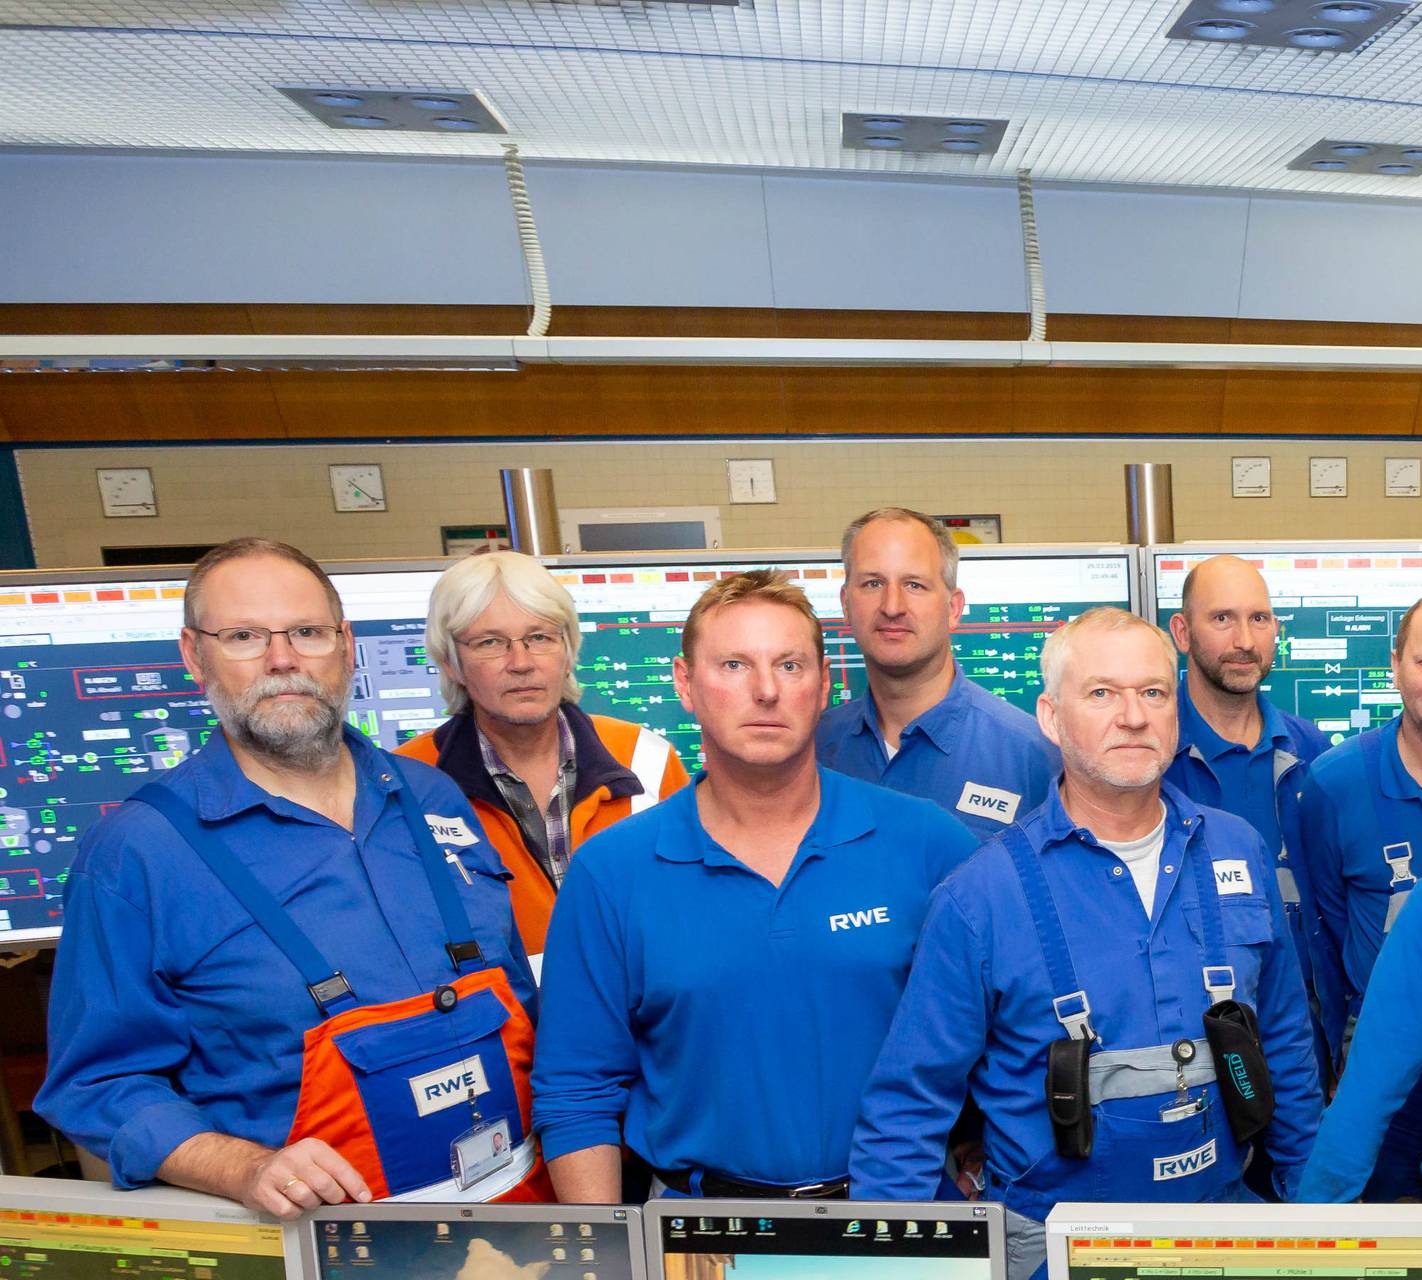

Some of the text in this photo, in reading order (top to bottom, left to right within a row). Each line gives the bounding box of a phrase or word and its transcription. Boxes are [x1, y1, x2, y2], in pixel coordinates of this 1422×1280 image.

[969, 794, 1009, 813] RWE
[1216, 871, 1244, 884] WE
[829, 906, 891, 932] RWE
[424, 1071, 477, 1101] RWE
[1231, 1053, 1255, 1100] INFIELD
[1160, 1147, 1214, 1177] RWE
